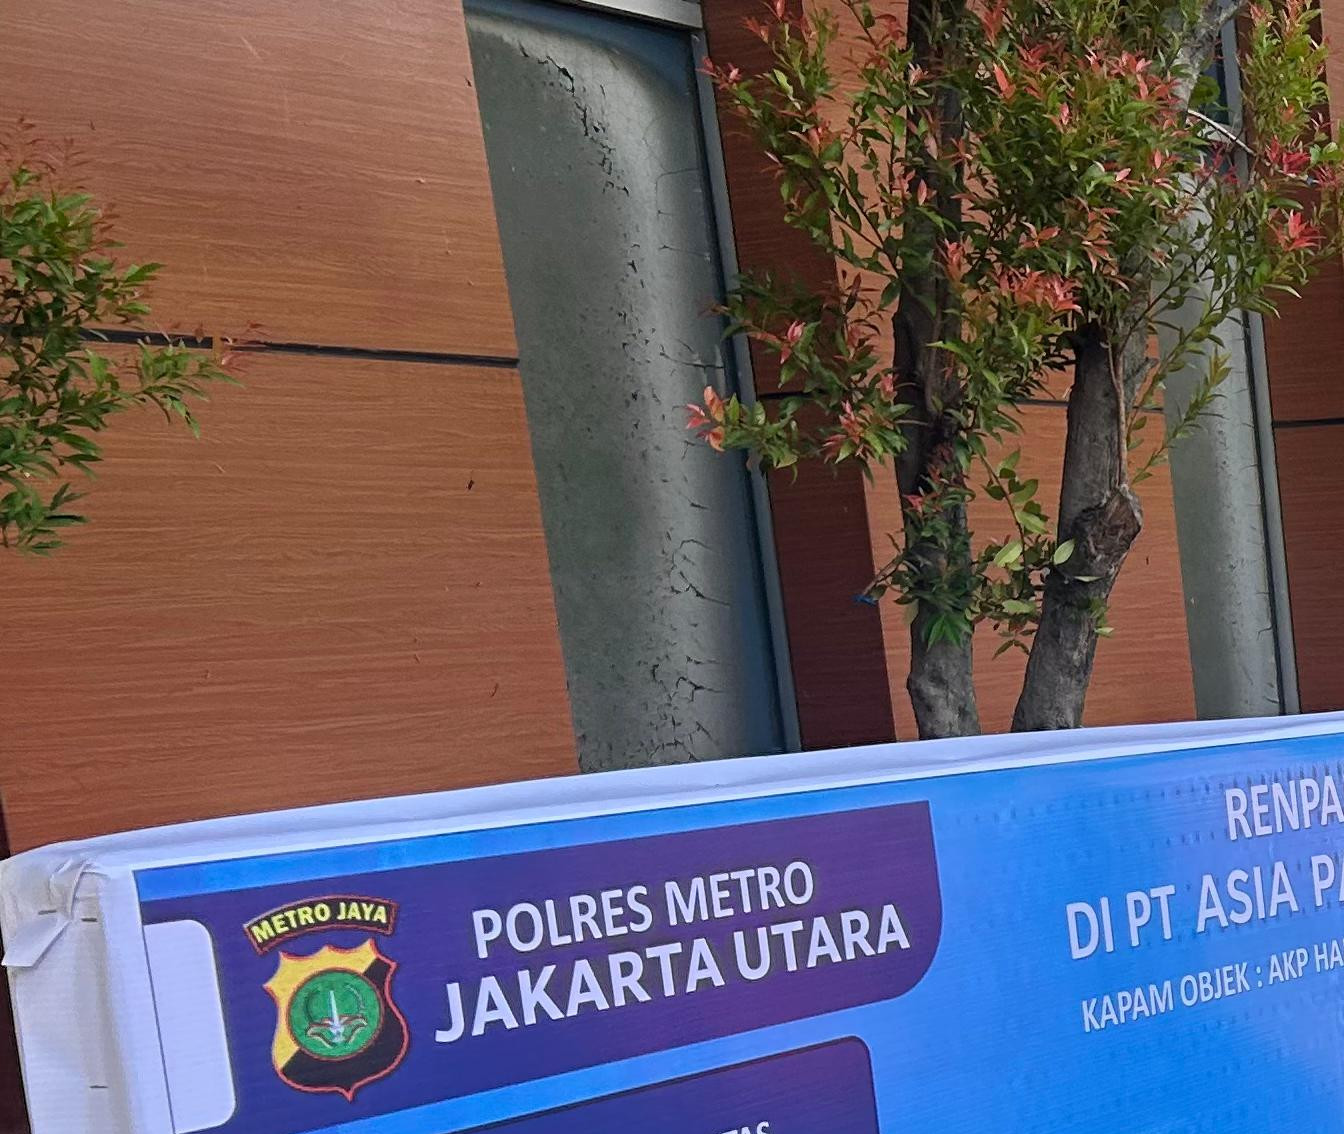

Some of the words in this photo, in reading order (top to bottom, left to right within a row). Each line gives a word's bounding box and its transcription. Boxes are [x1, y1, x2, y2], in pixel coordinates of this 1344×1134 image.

[252, 903, 331, 943] METRO
[337, 902, 387, 923] JAYA
[473, 884, 653, 958] POLRES
[665, 861, 815, 927] METRO
[1066, 900, 1113, 960] DI
[1128, 885, 1176, 946] PT
[1197, 860, 1298, 933] ASIA
[435, 937, 726, 1044] JAKARTA
[735, 904, 911, 982] UTARA
[1082, 990, 1174, 1033] KAPAM
[1180, 965, 1251, 1008] OBJEK
[1269, 951, 1308, 985] AKP
